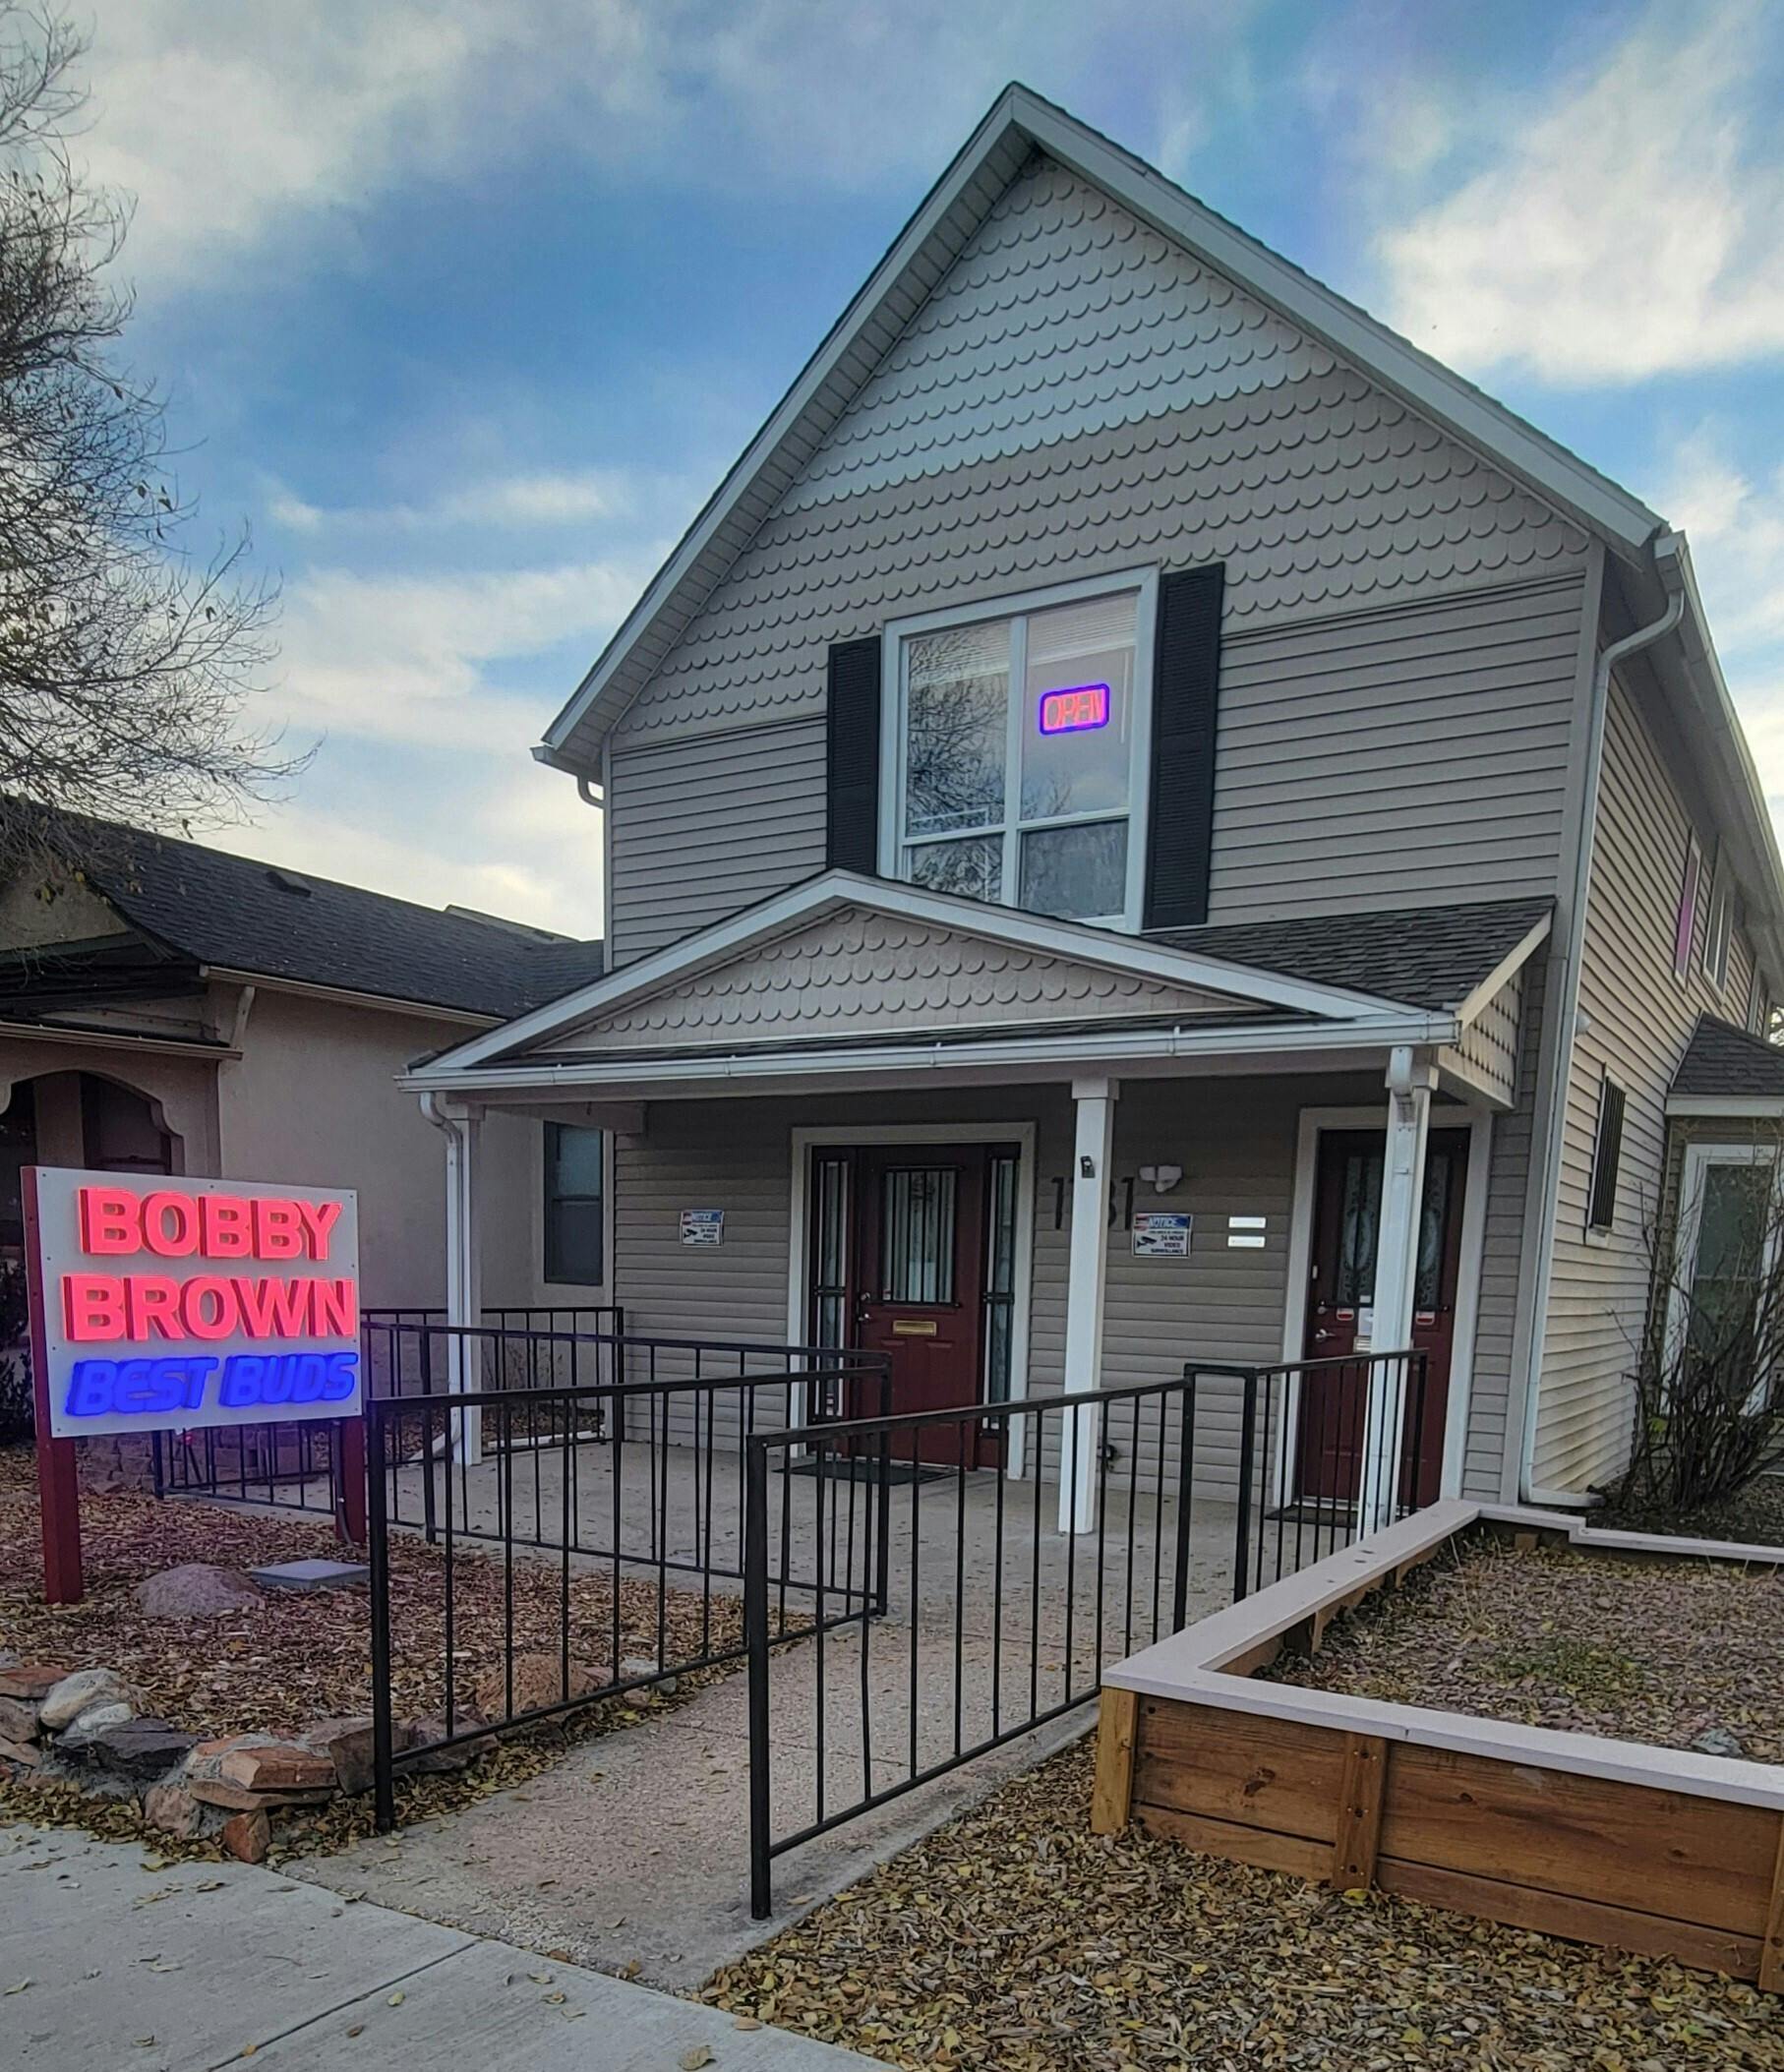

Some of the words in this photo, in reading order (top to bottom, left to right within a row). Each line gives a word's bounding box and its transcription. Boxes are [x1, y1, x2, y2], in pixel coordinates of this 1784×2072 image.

[1043, 689, 1105, 731] OPEN
[79, 1188, 342, 1261] BOBBY
[63, 1274, 355, 1341] BROWN
[65, 1357, 219, 1416] BEST
[219, 1352, 358, 1407] BUDS
